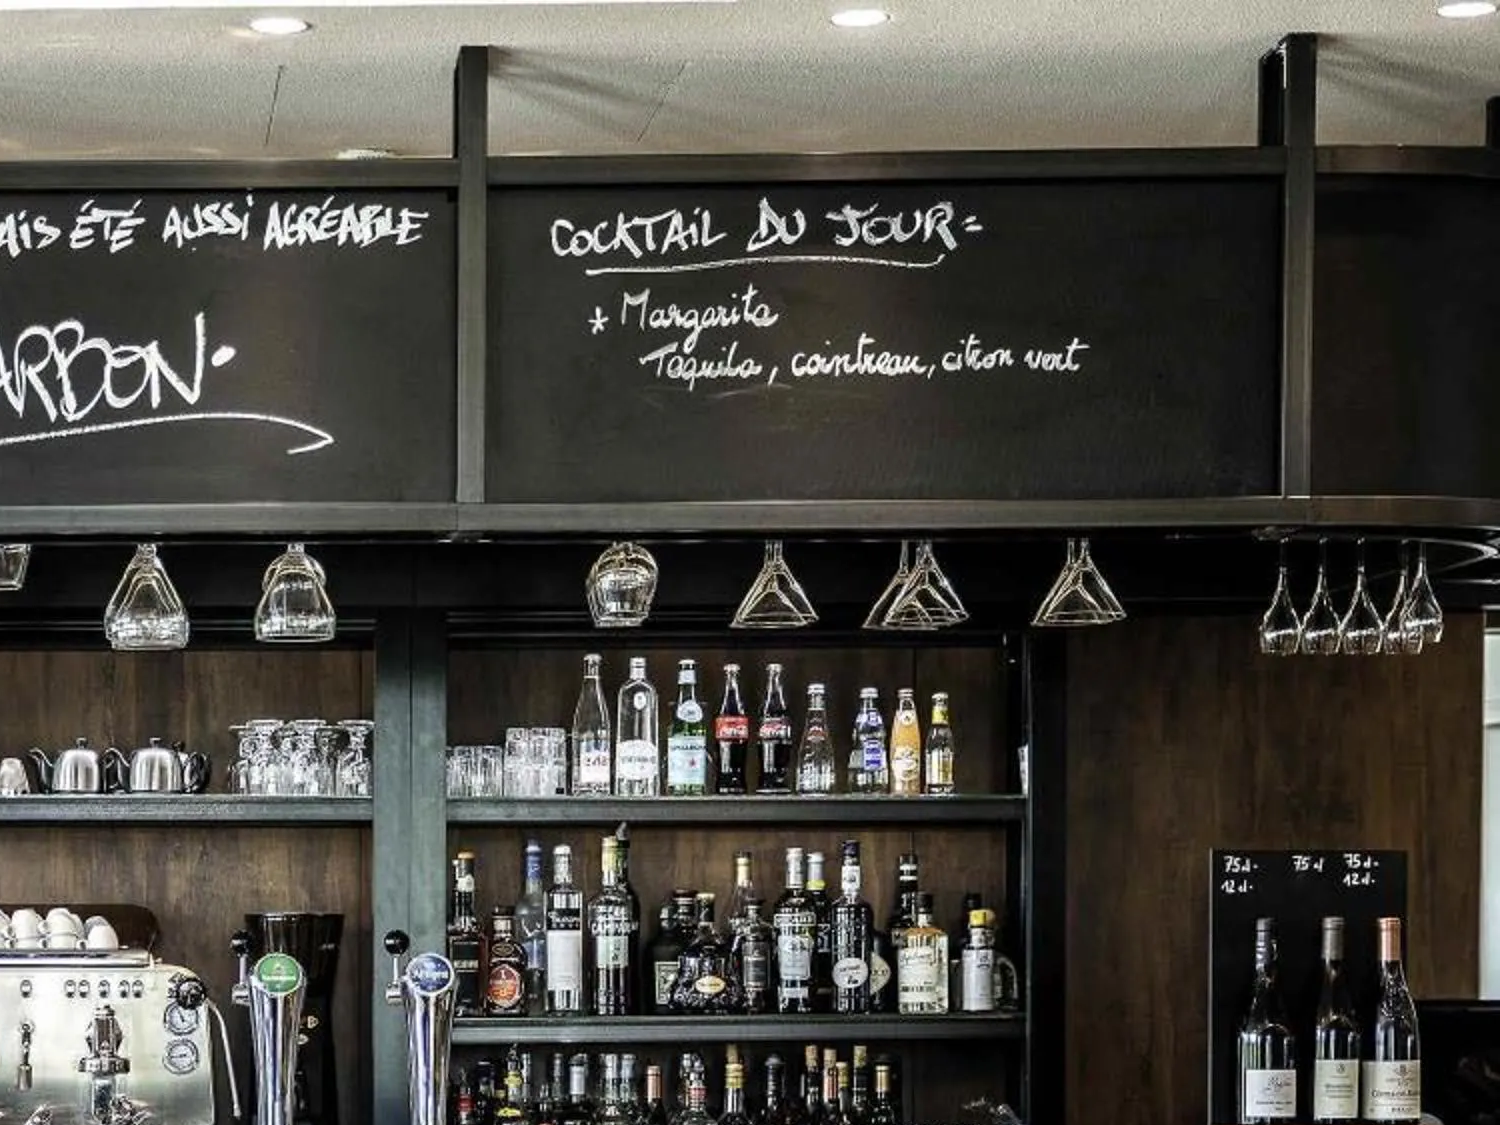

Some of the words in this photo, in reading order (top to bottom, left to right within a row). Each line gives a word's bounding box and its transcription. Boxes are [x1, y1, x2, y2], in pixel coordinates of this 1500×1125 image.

[69, 198, 146, 253] ÉTÉ
[263, 196, 429, 251] AGRÉABLE
[746, 198, 806, 252] DU
[942, 333, 1014, 371] citron
[1024, 337, 1090, 371] vert
